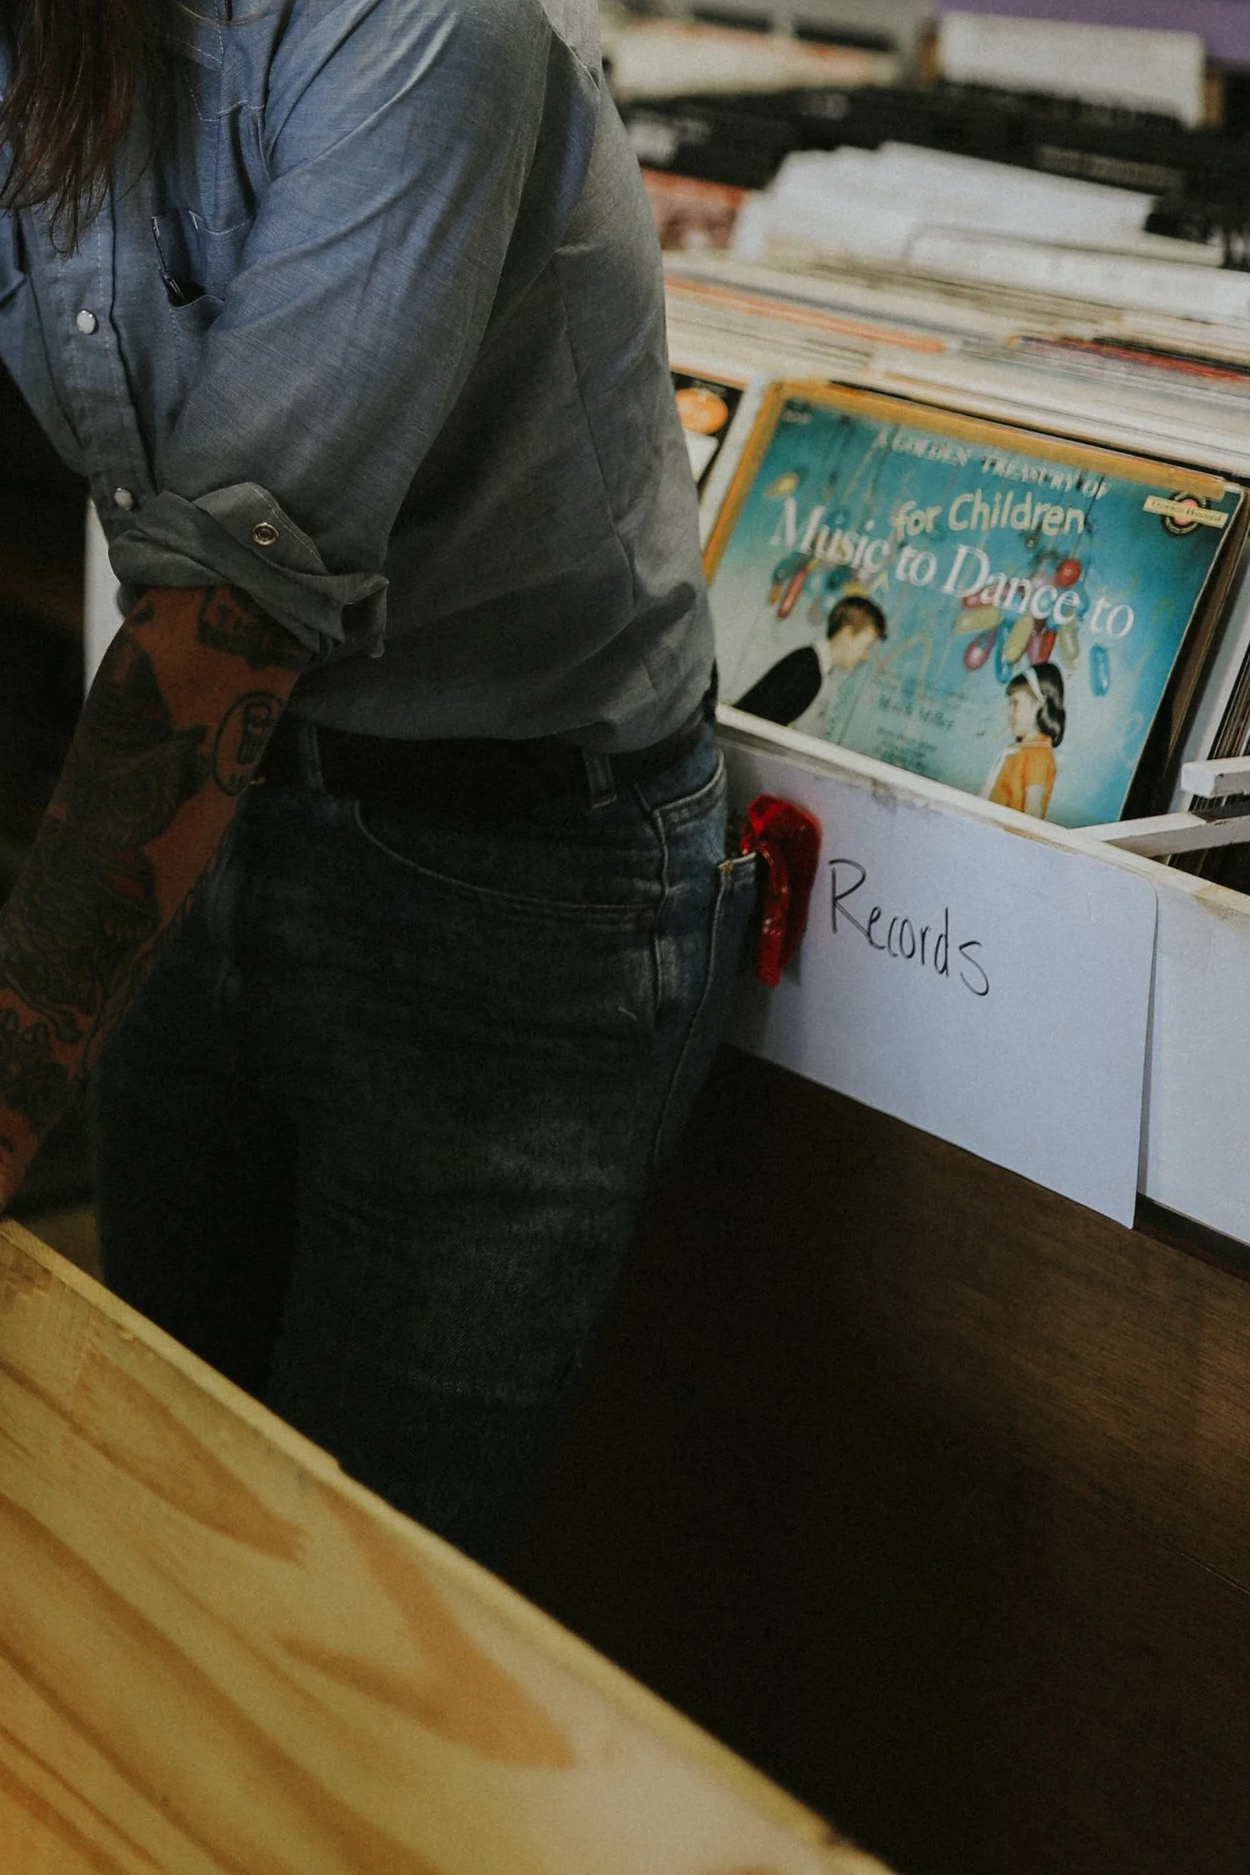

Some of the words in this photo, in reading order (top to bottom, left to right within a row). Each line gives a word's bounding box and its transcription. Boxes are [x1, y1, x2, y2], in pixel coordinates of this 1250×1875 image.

[768, 494, 891, 574] Music
[895, 544, 938, 586] to
[940, 543, 1081, 626] Dance
[1089, 595, 1135, 639] to
[892, 500, 943, 542] for
[947, 487, 1086, 536] Children
[827, 858, 990, 997] Records
